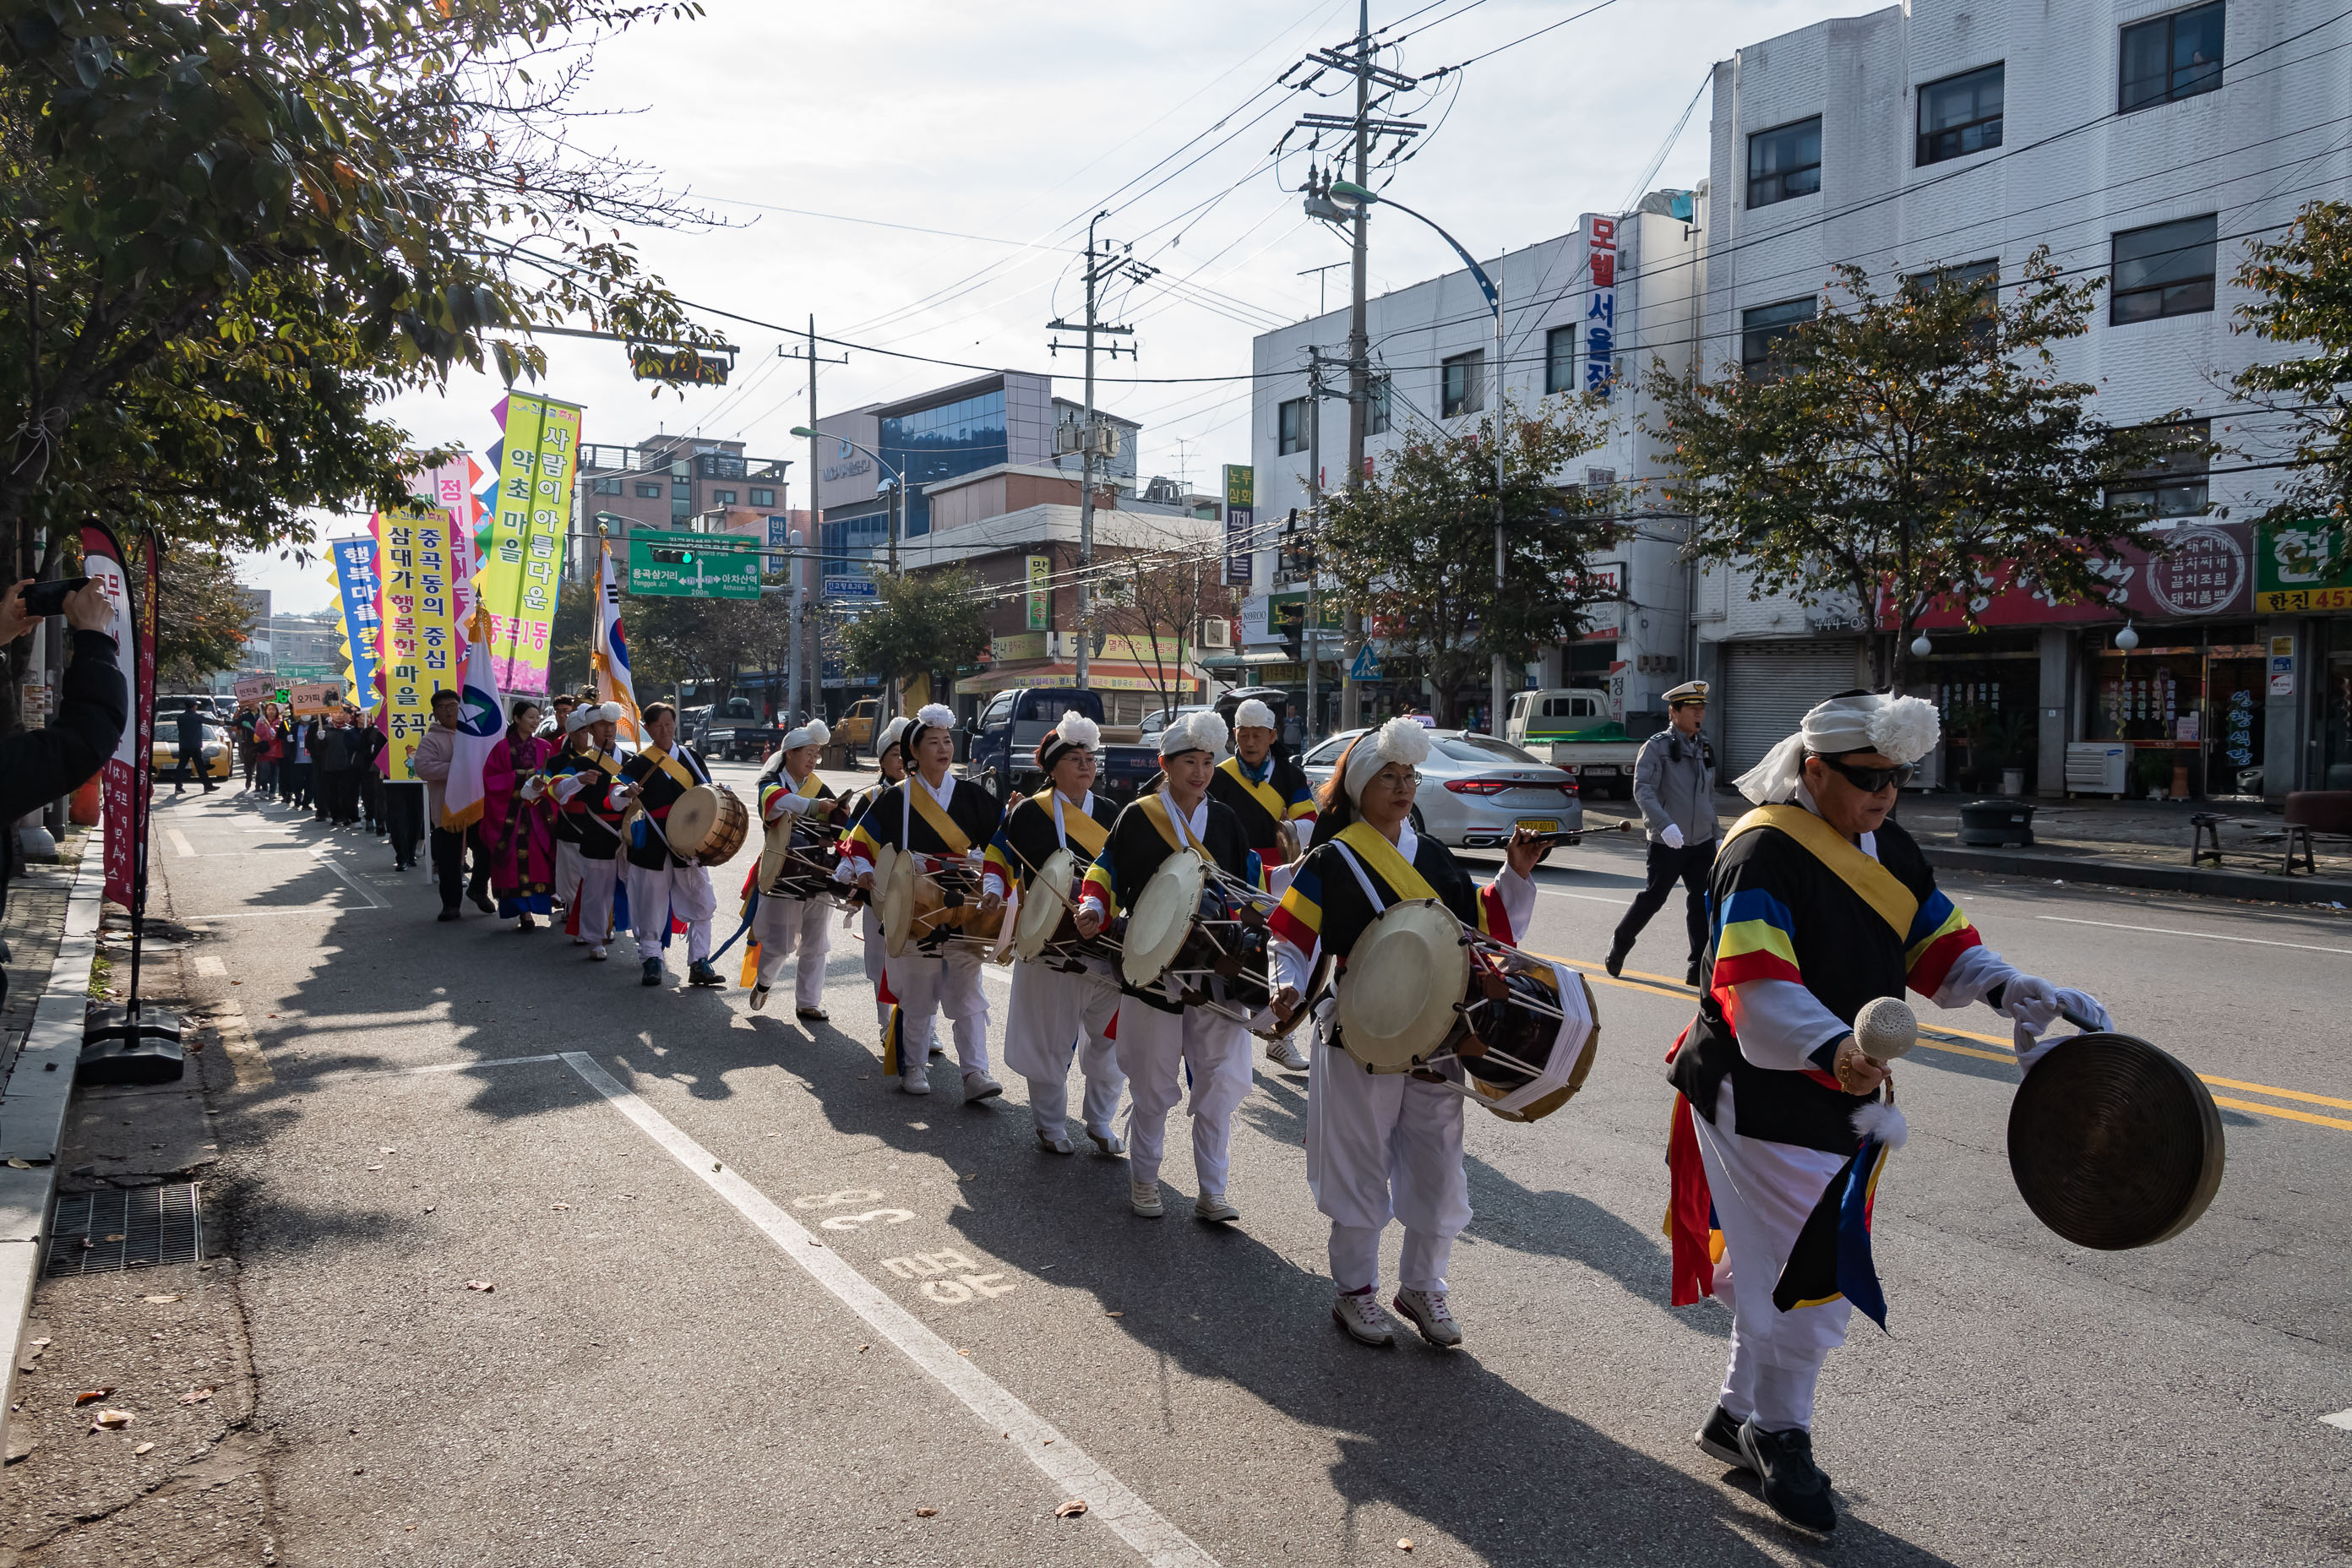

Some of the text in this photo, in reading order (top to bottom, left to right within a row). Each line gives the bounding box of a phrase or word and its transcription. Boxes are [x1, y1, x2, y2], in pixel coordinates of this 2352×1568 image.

[1590, 218, 1616, 288] 모텔
[1587, 293, 1614, 398] 서울장
[507, 448, 535, 500] 약초
[538, 427, 569, 504] 사람이
[1228, 470, 1252, 486] 노루
[1228, 488, 1252, 504] 삼화
[387, 526, 415, 590] 삼대가
[499, 510, 527, 564] 마을
[416, 528, 445, 618] 중곡동의
[524, 509, 559, 610] 아름다운
[633, 568, 678, 580] 용곡삼거리
[722, 574, 758, 585] 아차산역
[2170, 572, 2227, 588] 갈치조림
[633, 580, 657, 588] Yonggok
[2268, 591, 2310, 611] 한진
[390, 594, 419, 657] 행복한
[1243, 610, 1266, 621] NOROO
[422, 626, 446, 669] 중심
[297, 694, 320, 704] 오가피
[394, 665, 420, 706] 마을
[880, 1247, 1019, 1304] 유료
